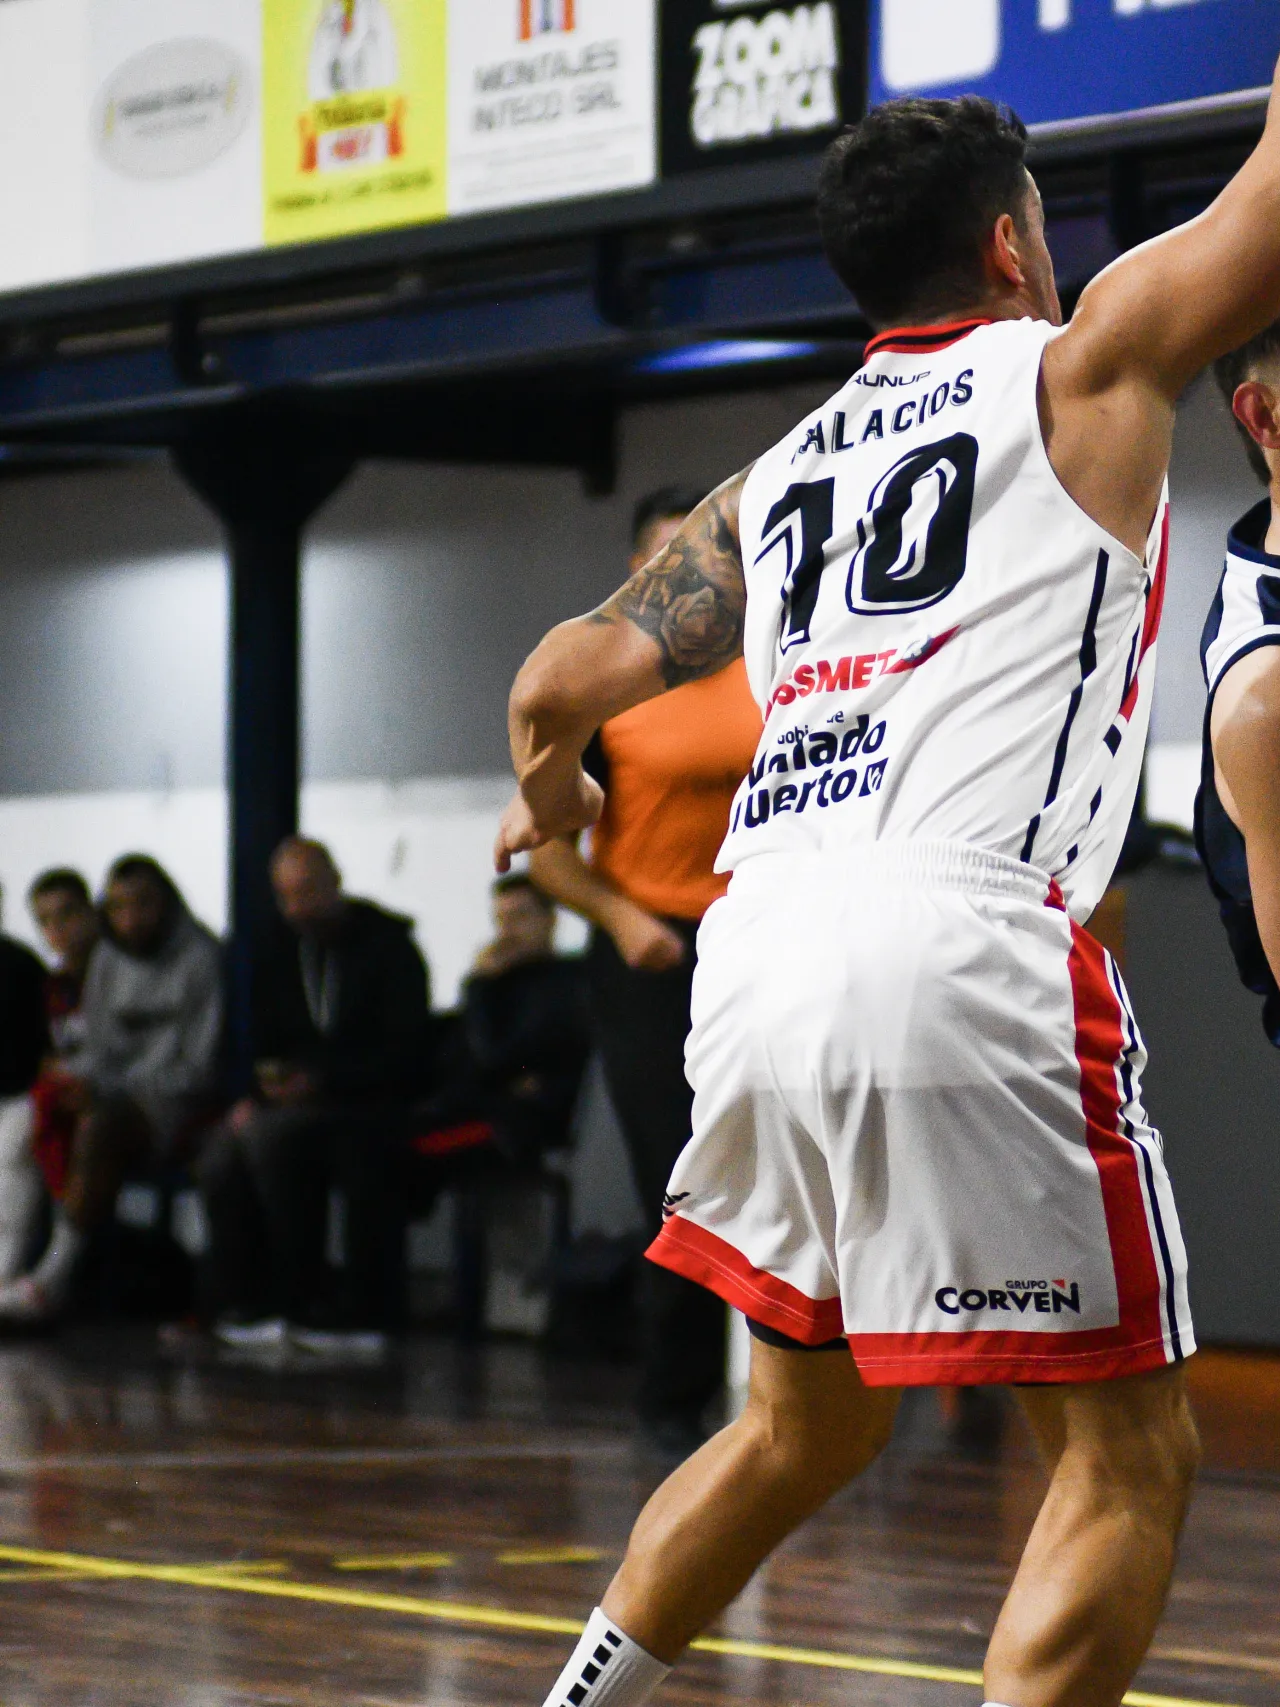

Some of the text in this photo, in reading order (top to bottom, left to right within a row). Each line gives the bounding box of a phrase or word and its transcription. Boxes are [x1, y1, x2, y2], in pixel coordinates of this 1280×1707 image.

[474, 40, 619, 93] MONTAJES
[692, 3, 837, 90] ZOOM
[789, 369, 974, 465] ALACIOS
[753, 432, 978, 656] 10
[935, 1282, 1081, 1315] CORVEN
[1005, 1280, 1048, 1290] GRUPO
